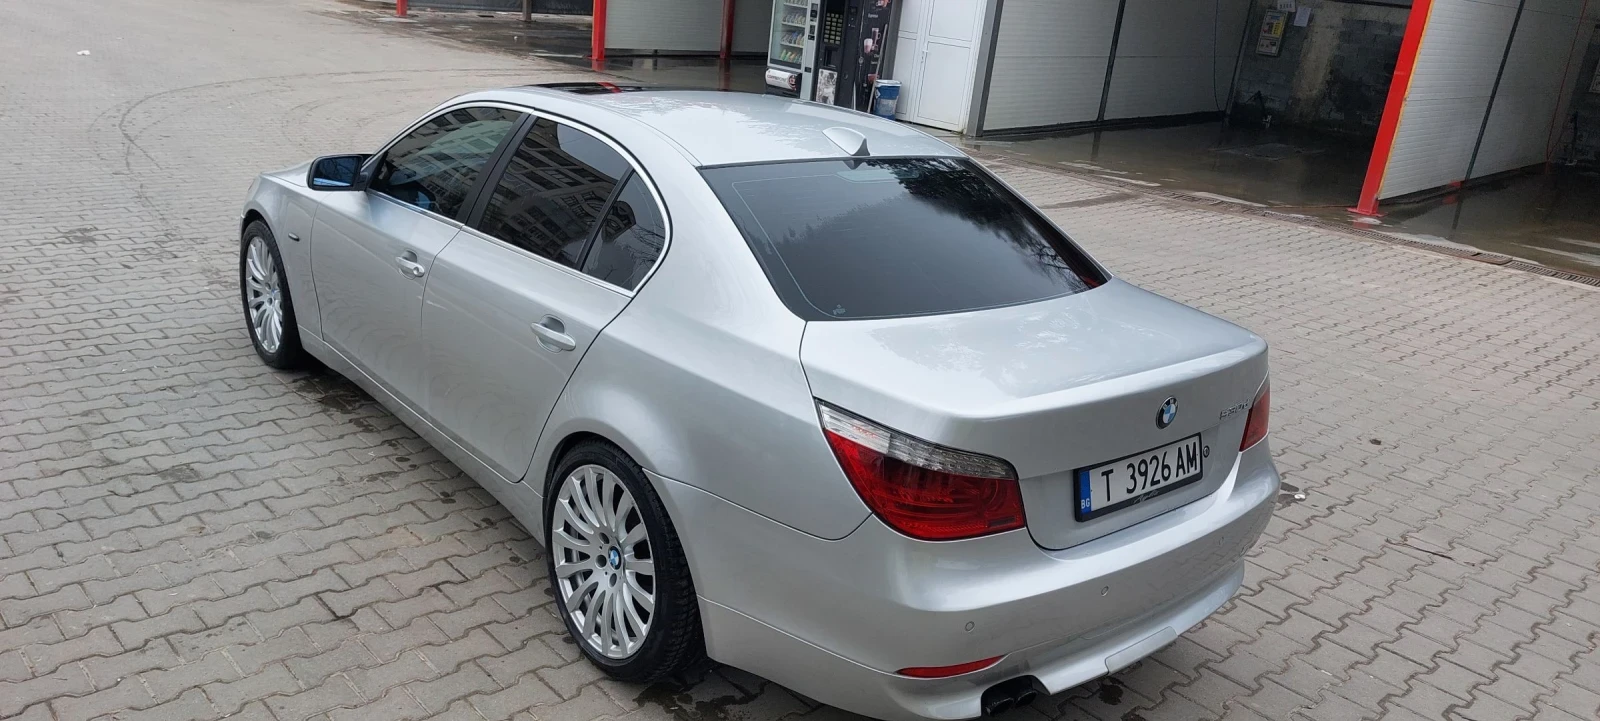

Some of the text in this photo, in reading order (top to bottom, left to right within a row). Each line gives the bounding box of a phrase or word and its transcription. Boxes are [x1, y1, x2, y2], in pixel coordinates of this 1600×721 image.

[1101, 469, 1114, 502] T
[1126, 451, 1171, 494] 3926
[1175, 442, 1198, 478] AM
[1081, 498, 1090, 509] BG
